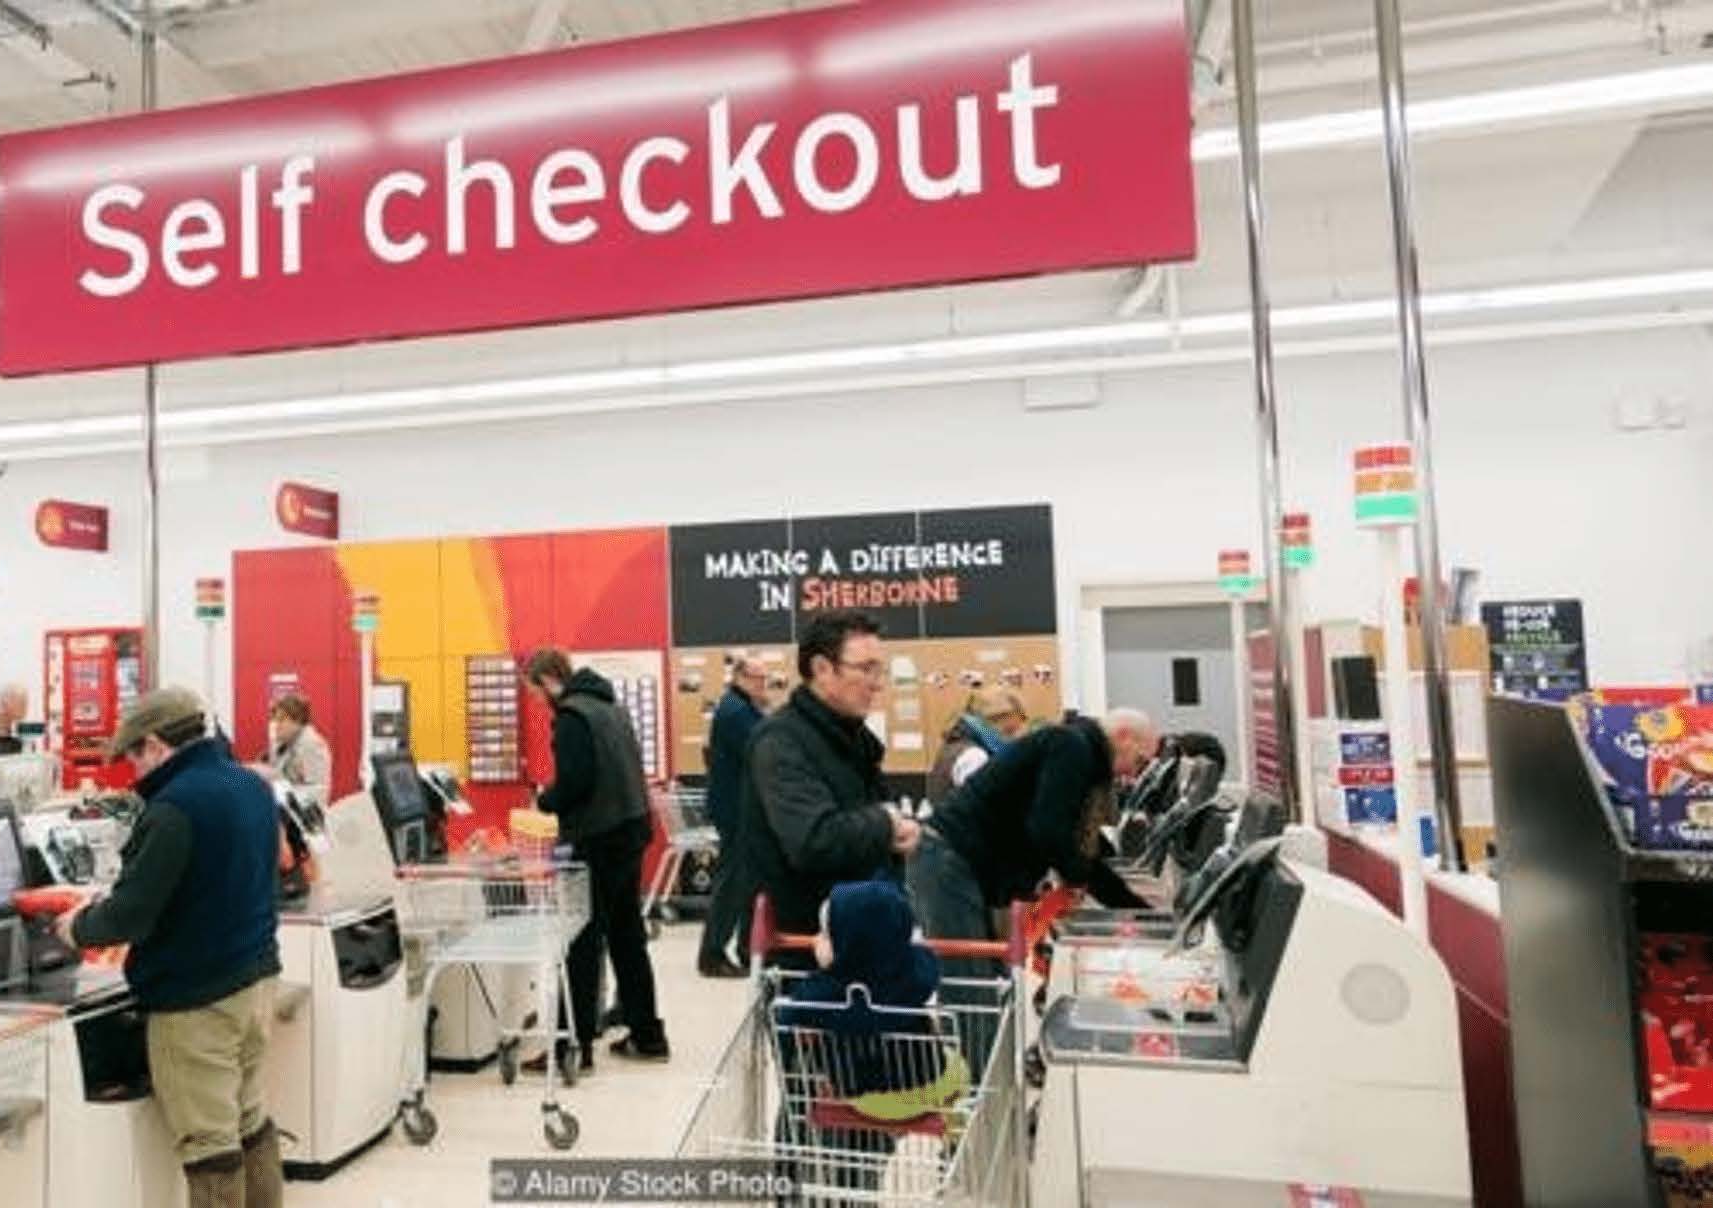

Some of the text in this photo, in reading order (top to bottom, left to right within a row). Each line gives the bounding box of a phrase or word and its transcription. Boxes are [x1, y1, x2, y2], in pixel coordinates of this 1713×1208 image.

[79, 52, 1062, 297] Self checkout
[705, 540, 1003, 579] MAKING A DIFFERENCE
[759, 576, 959, 610] IN SHERBORNE
